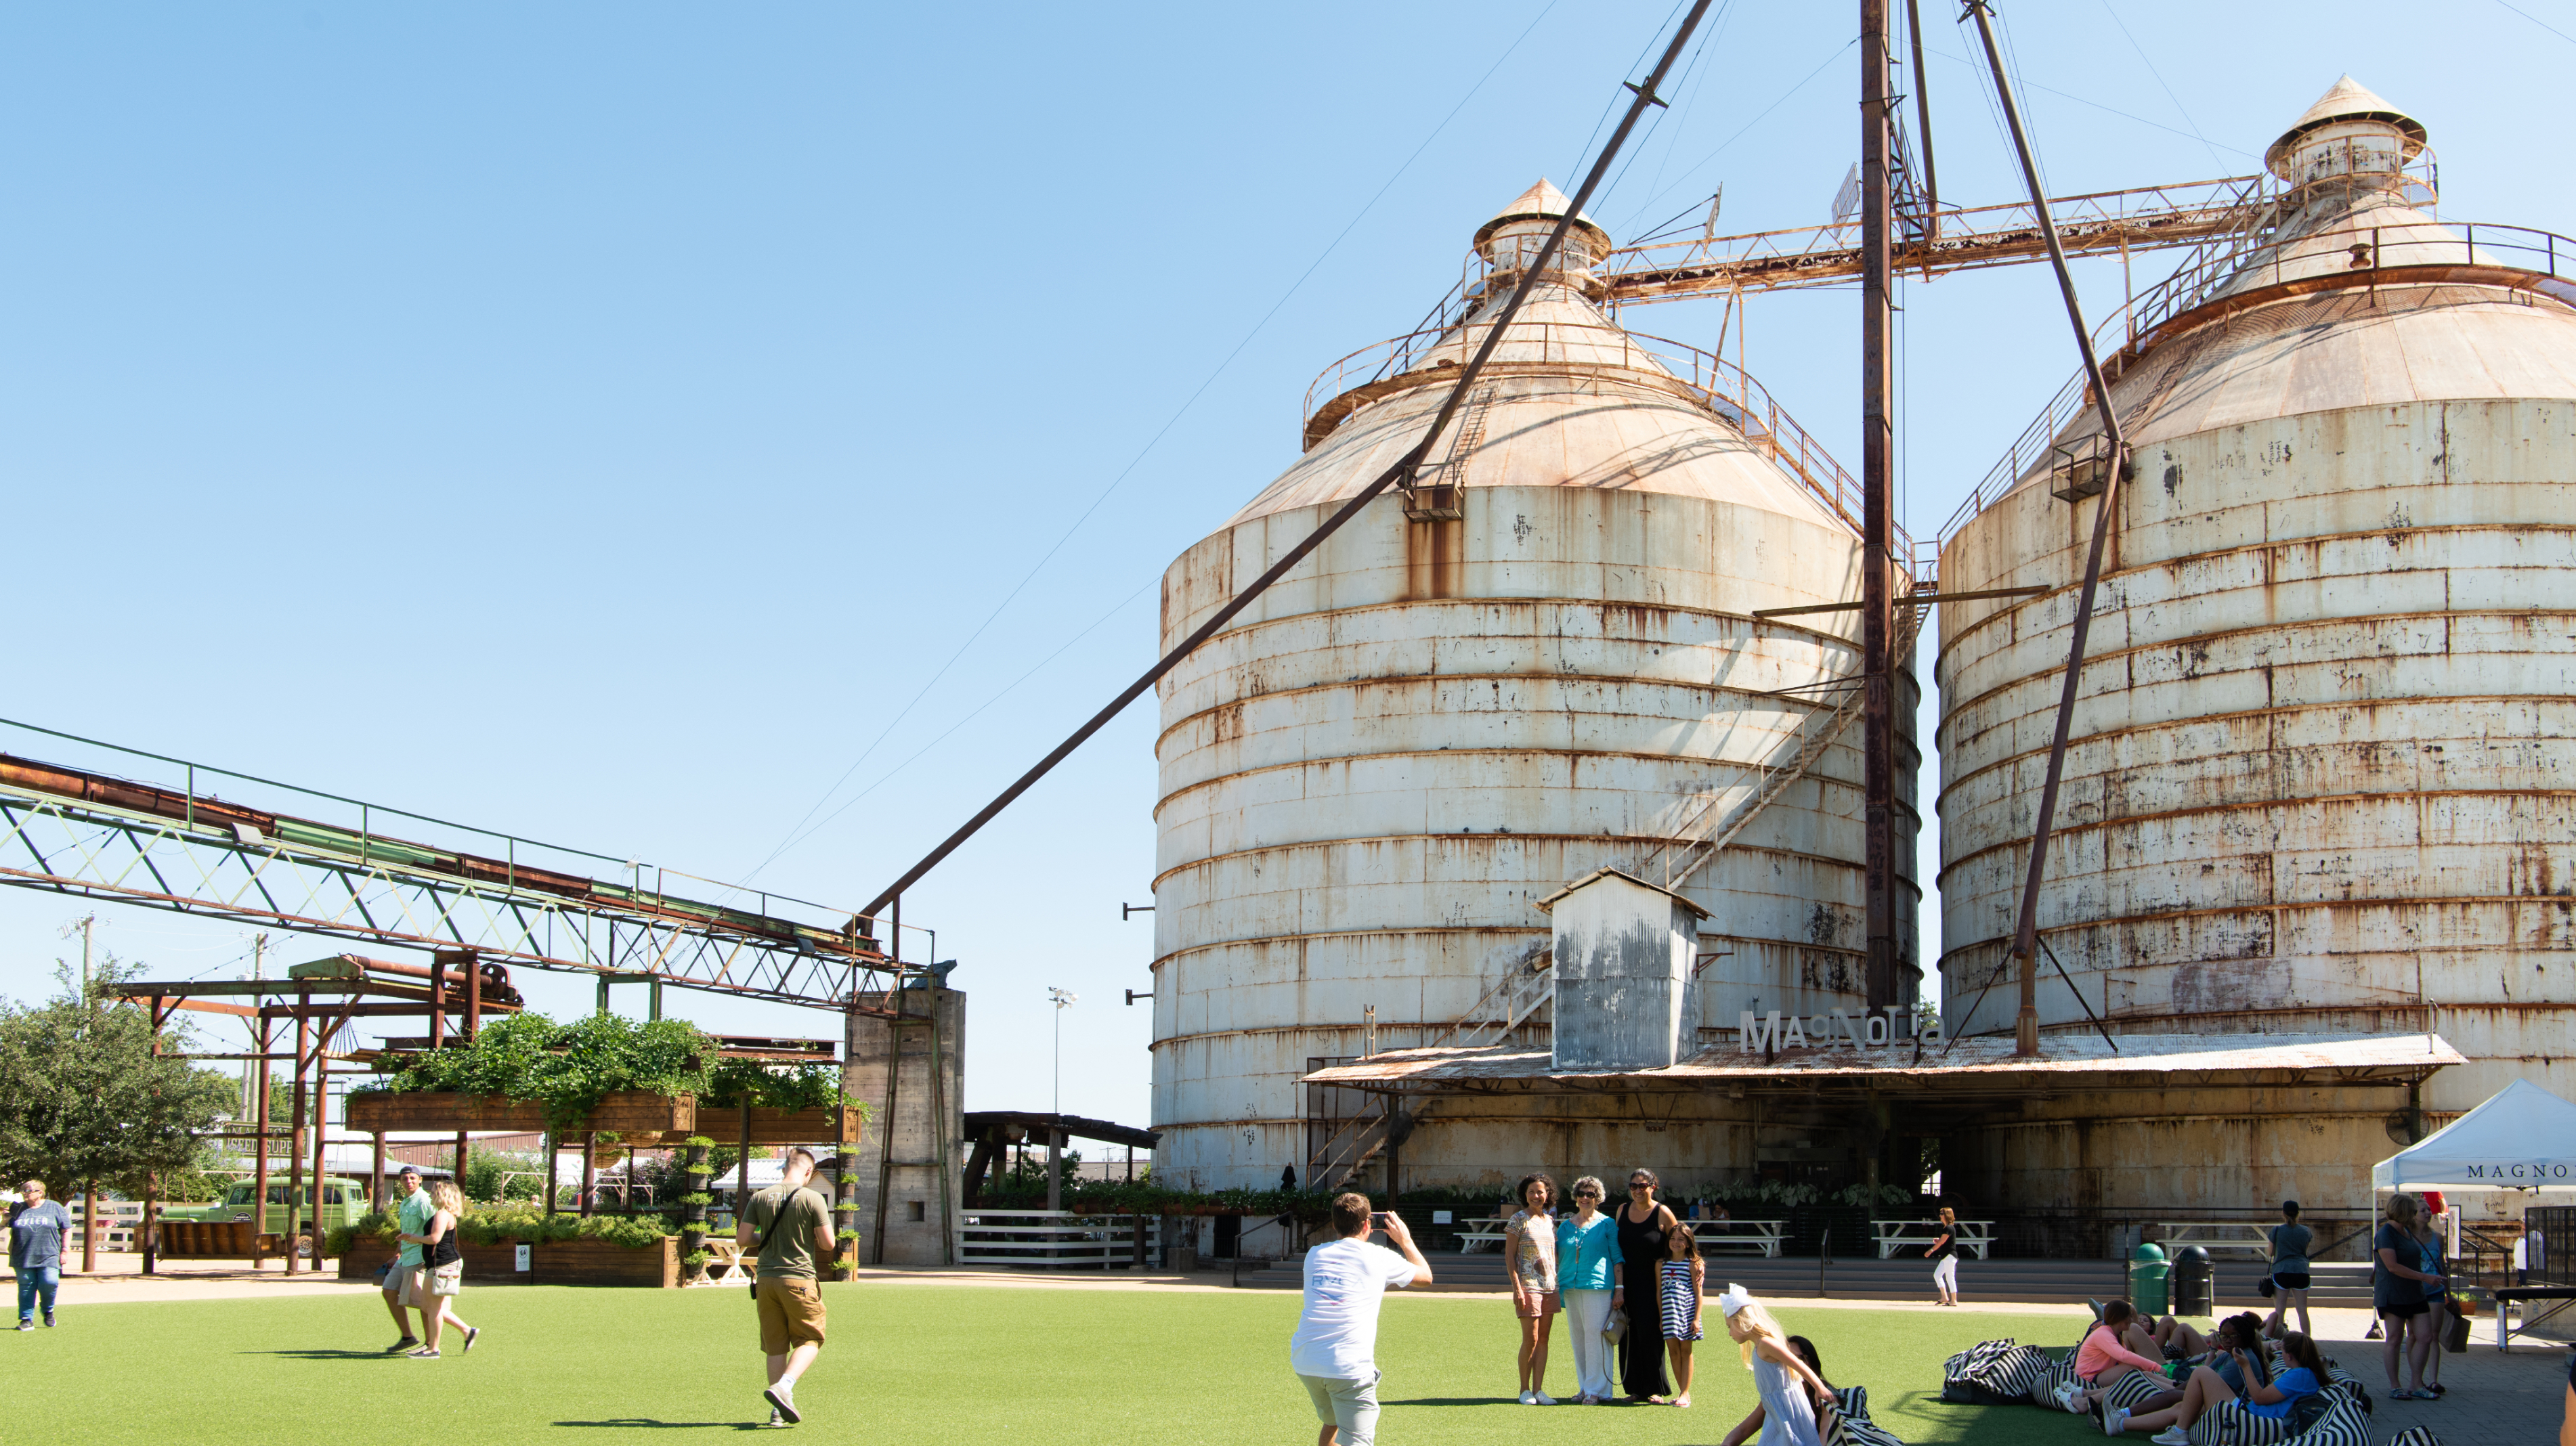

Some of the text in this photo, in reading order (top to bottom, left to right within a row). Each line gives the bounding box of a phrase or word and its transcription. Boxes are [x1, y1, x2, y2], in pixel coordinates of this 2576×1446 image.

[230, 1138, 306, 1154] SEED SUPP
[2468, 1164, 2576, 1178] MAGNO
[768, 1191, 800, 1202] STAF
